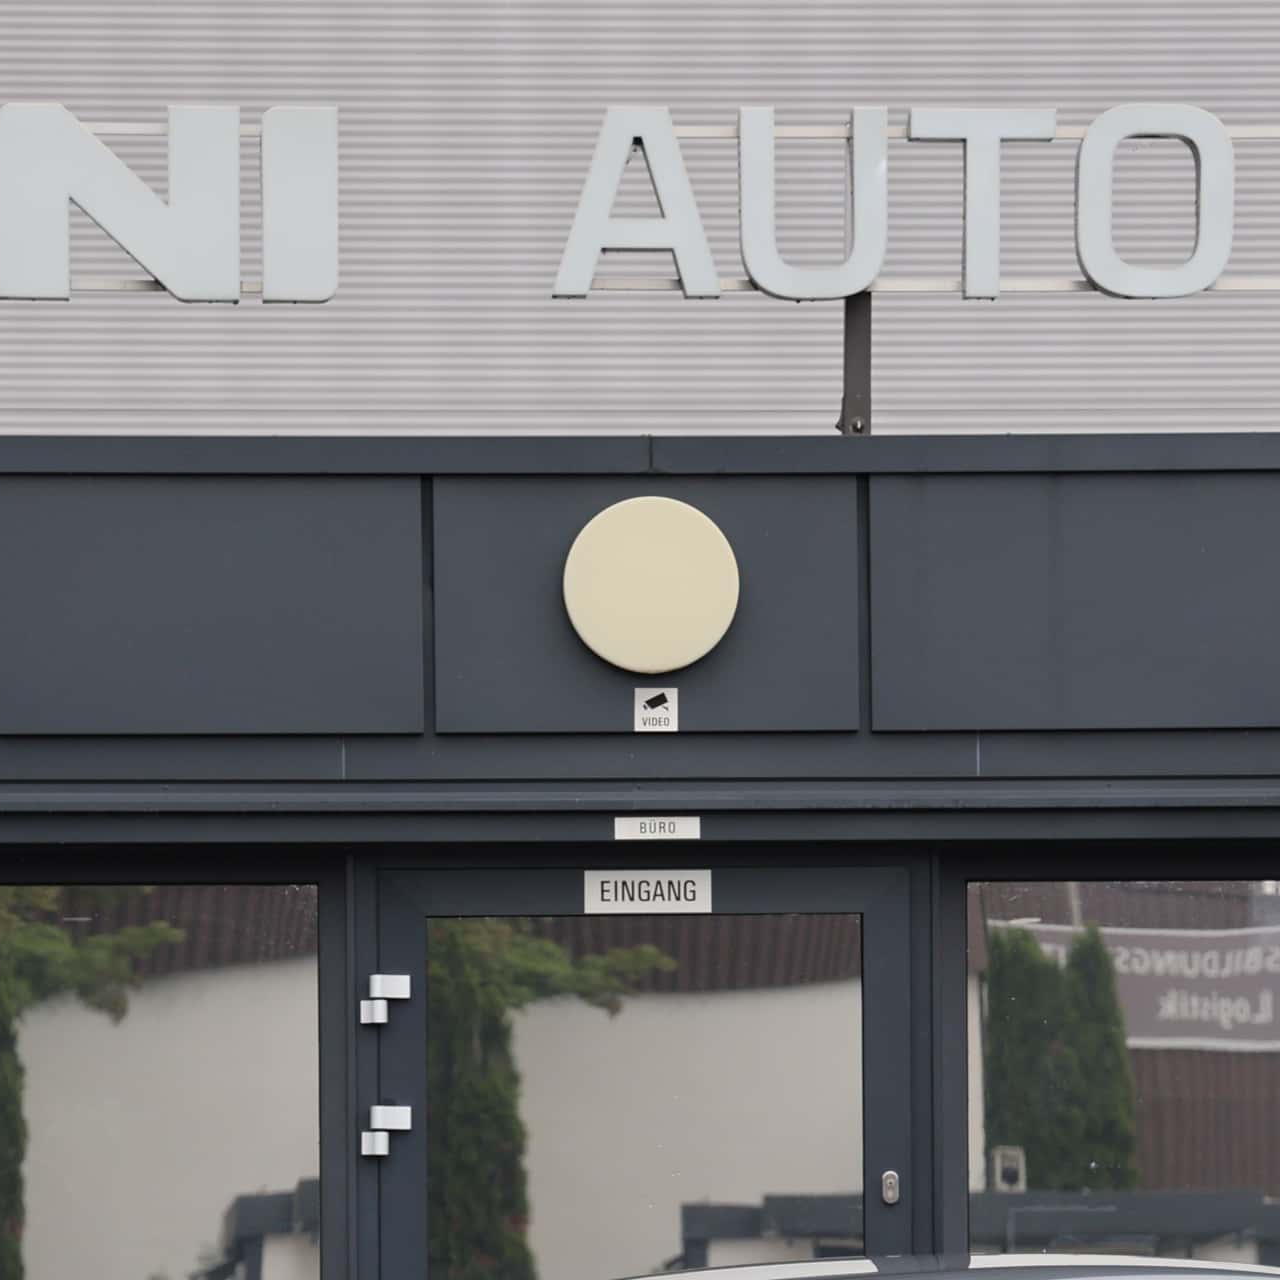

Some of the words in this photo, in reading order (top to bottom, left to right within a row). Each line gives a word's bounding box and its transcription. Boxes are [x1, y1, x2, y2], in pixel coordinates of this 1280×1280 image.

[552, 103, 1235, 302] AUTO
[641, 716, 670, 727] VIDEO
[639, 819, 676, 834] BÜRO
[600, 880, 696, 902] EINGANG
